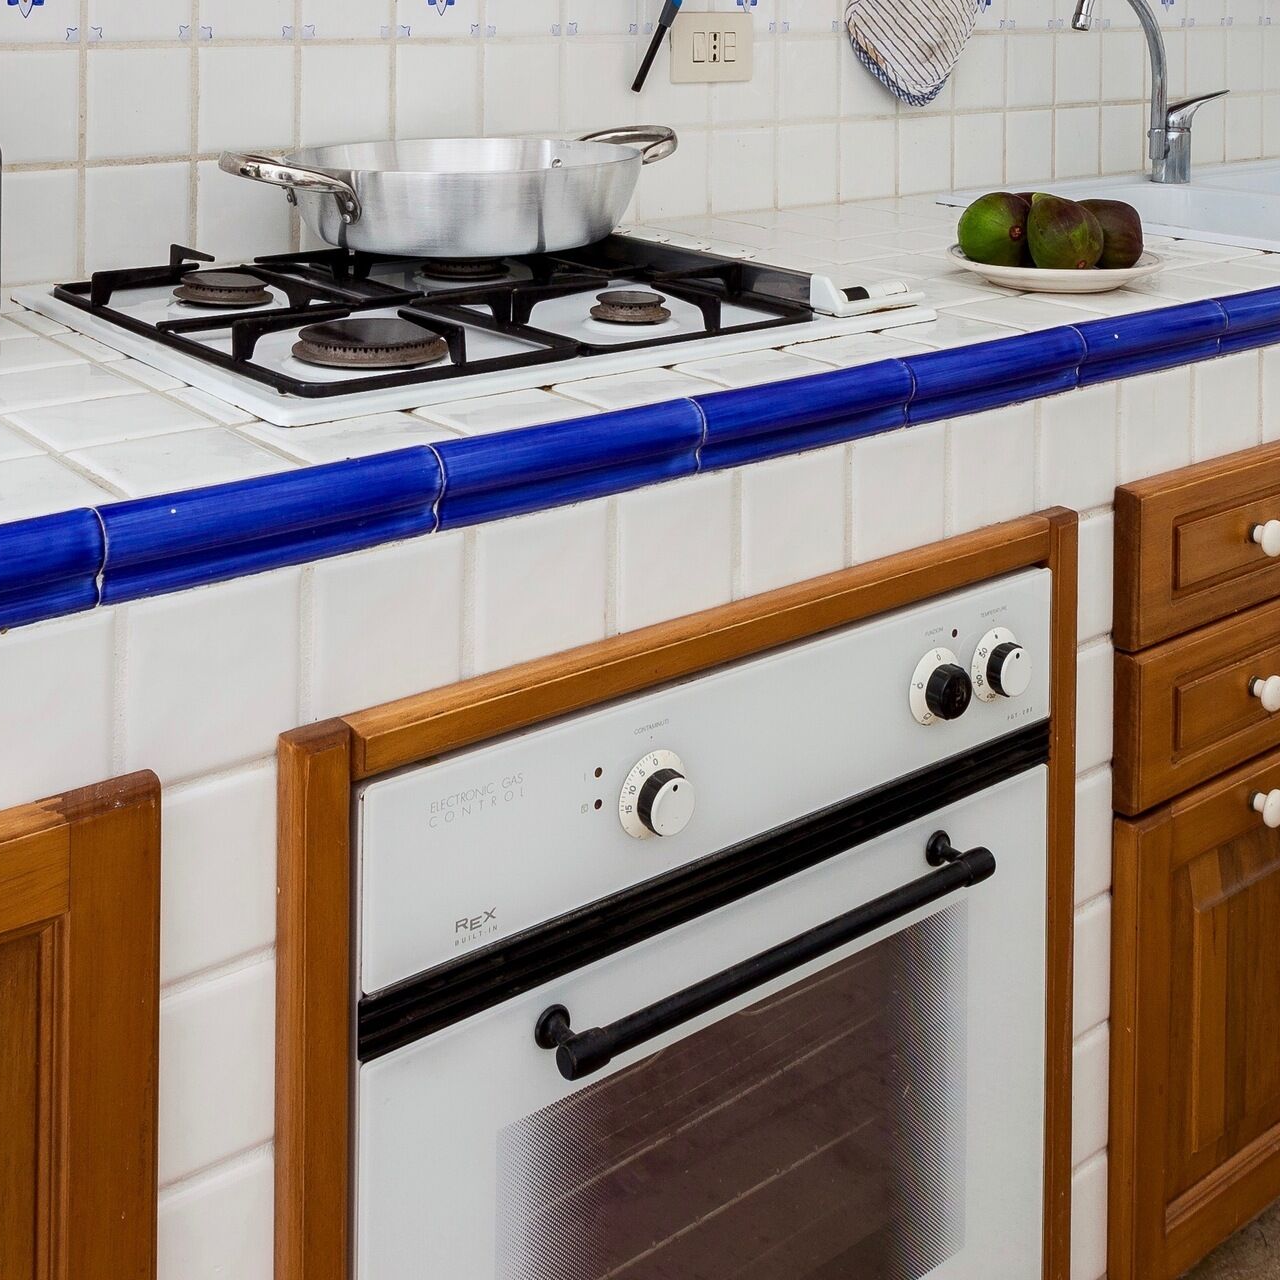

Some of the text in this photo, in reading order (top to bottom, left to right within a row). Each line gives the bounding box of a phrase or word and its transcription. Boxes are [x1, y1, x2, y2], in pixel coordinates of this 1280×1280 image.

[980, 648, 988, 659] 50
[652, 758, 658, 766] 0
[639, 769, 646, 777] 5
[430, 772, 524, 814] ELECTRONIC GAS
[628, 785, 637, 796] 10
[429, 786, 524, 828] CONTROL
[624, 804, 633, 815] 15
[456, 906, 496, 934] REX
[454, 924, 498, 947] BUILT-IN
